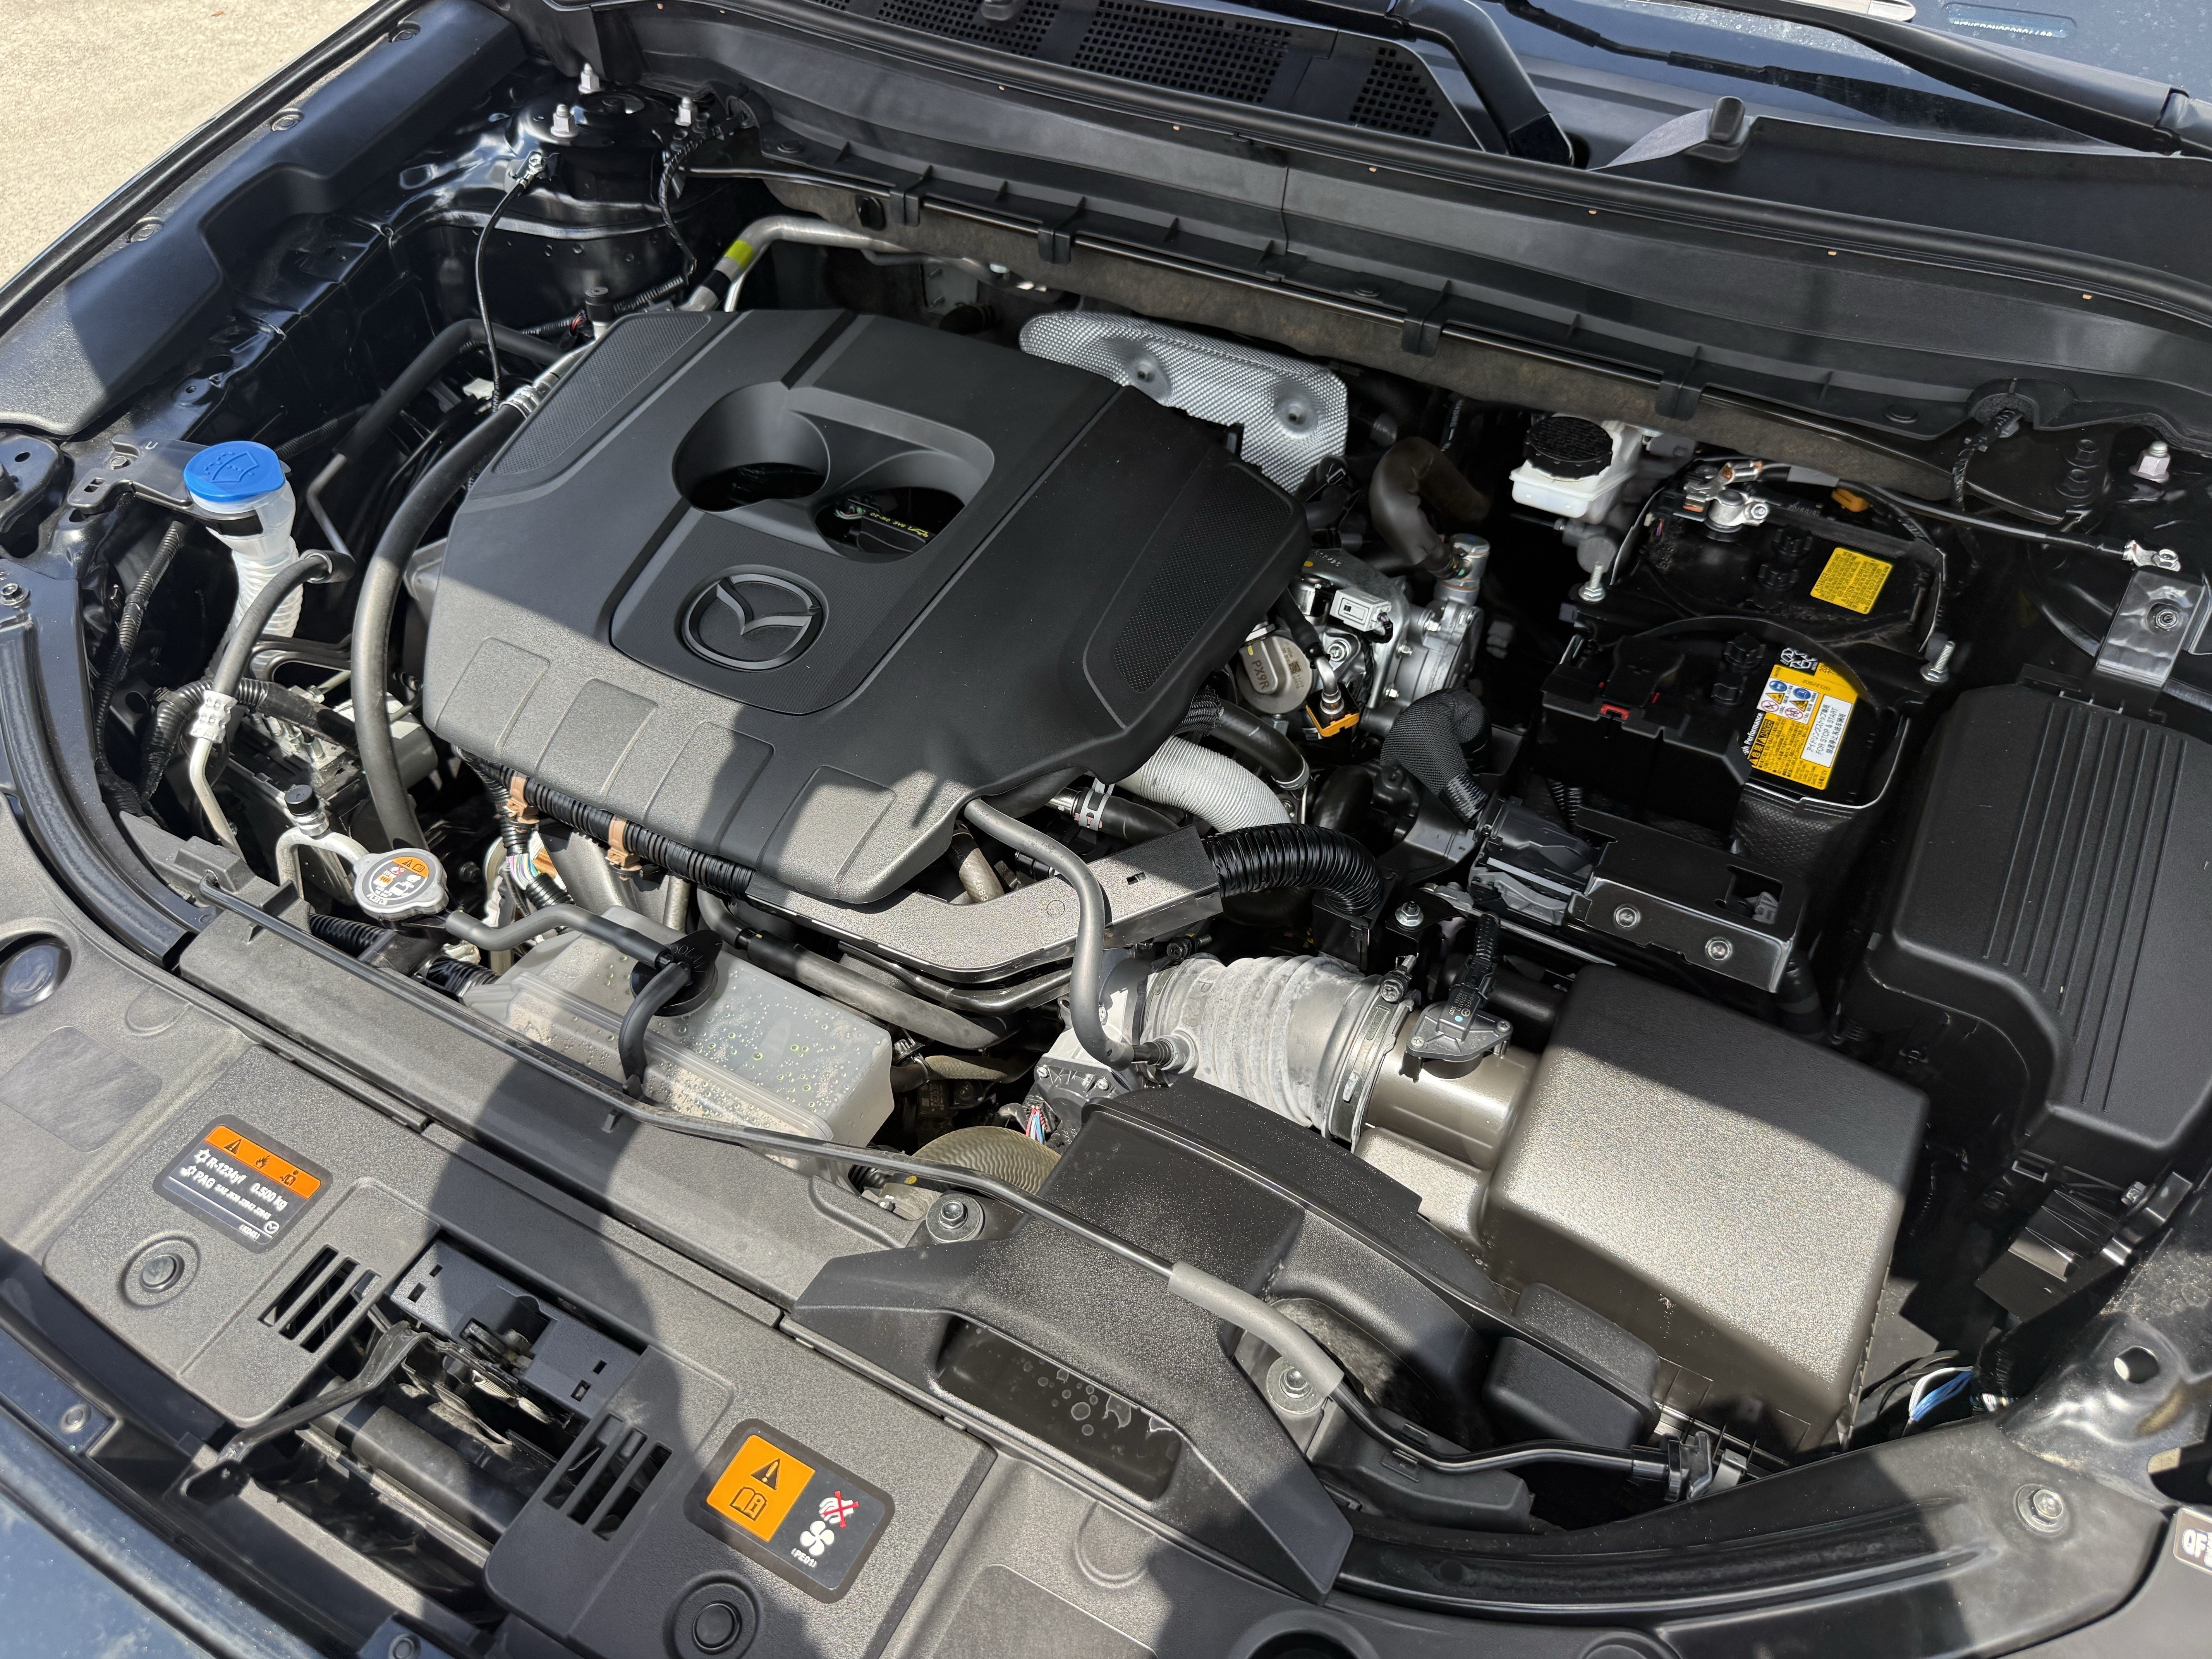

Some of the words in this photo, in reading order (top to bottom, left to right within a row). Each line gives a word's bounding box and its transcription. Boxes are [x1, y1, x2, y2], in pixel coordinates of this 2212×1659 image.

[1252, 660, 1269, 689] PX9R
[1826, 707, 1838, 724] START
[1748, 713, 1763, 745] Performance
[1761, 720, 1773, 738] DANGER
[1820, 728, 1831, 743] STOP
[1815, 742, 1826, 755] FOR
[193, 1170, 216, 1189] PAG
[215, 1184, 228, 1195] SAE
[206, 1158, 247, 1184] R-1234yf
[251, 1183, 276, 1202] 0.500
[274, 1195, 288, 1212] kg
